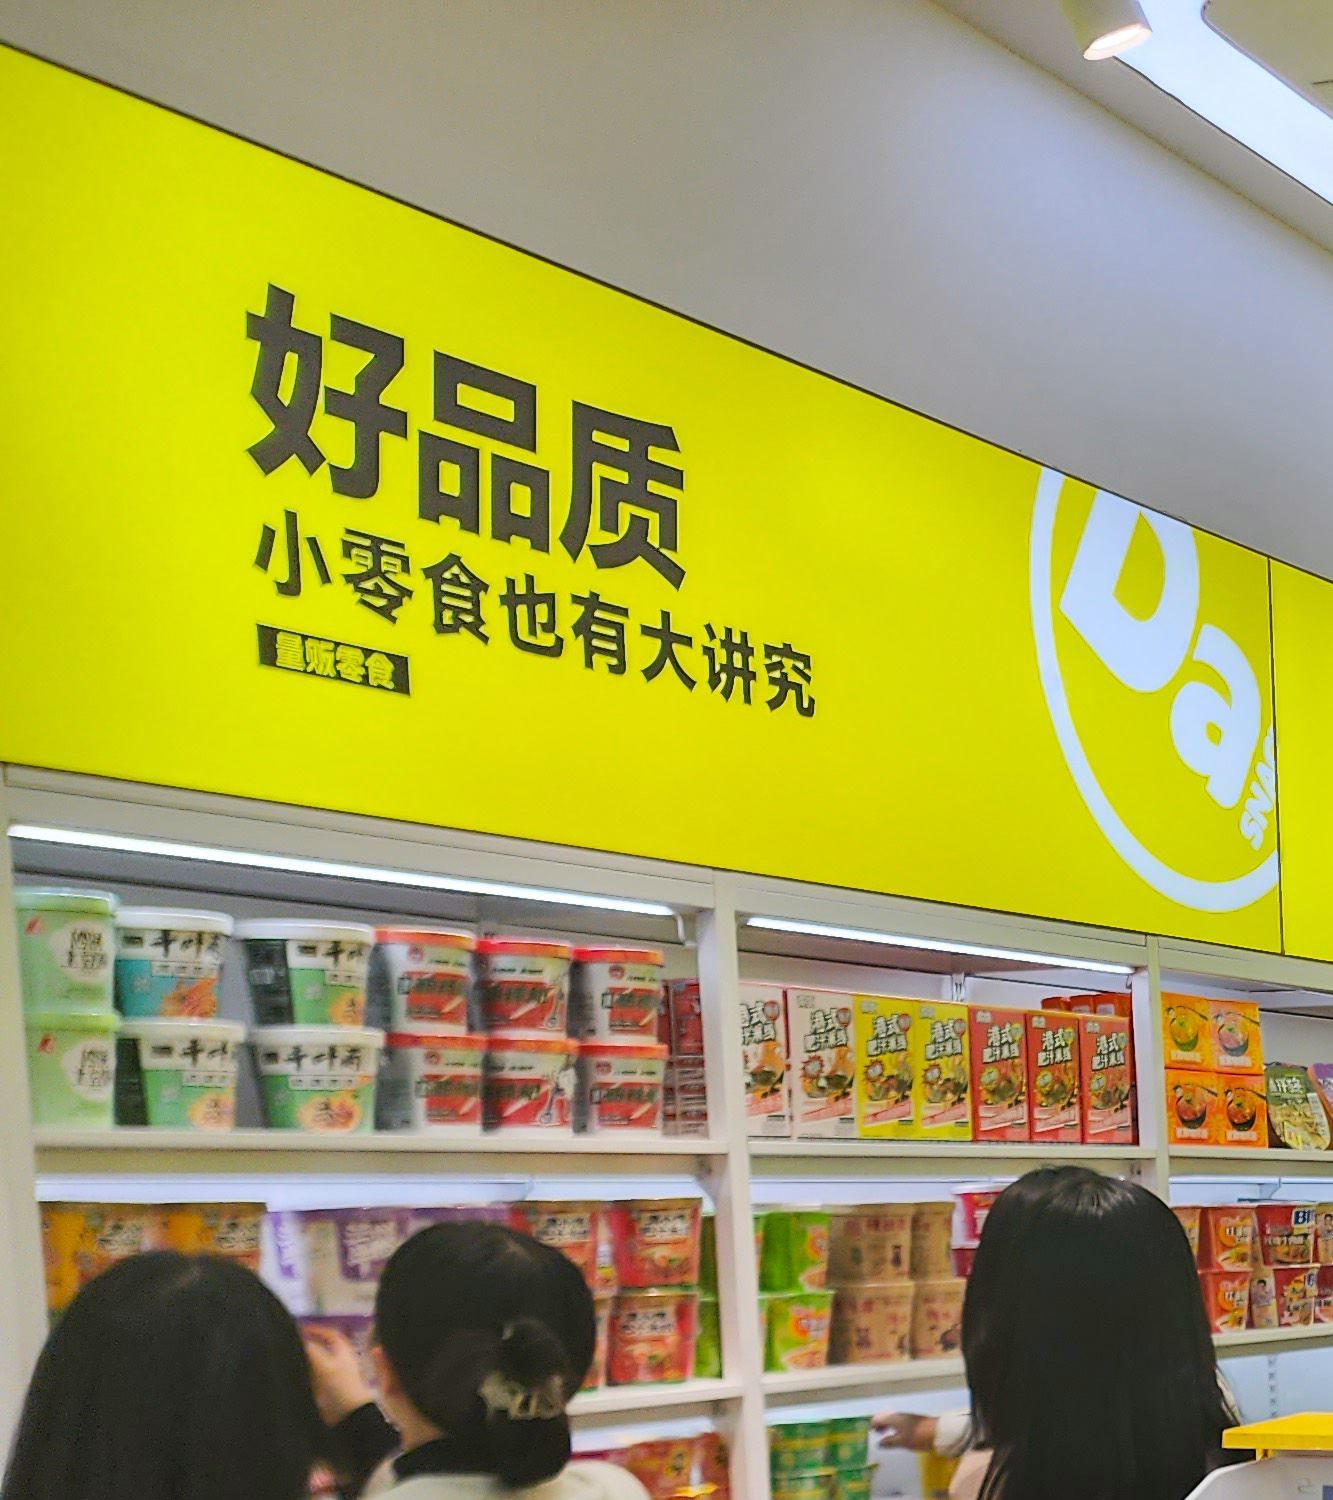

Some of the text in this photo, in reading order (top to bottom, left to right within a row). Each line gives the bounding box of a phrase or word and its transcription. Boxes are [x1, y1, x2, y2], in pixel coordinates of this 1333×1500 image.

[245, 283, 686, 590] 好品质
[254, 509, 817, 719] 小零食也有大讲究
[274, 632, 396, 690] 量贩零食
